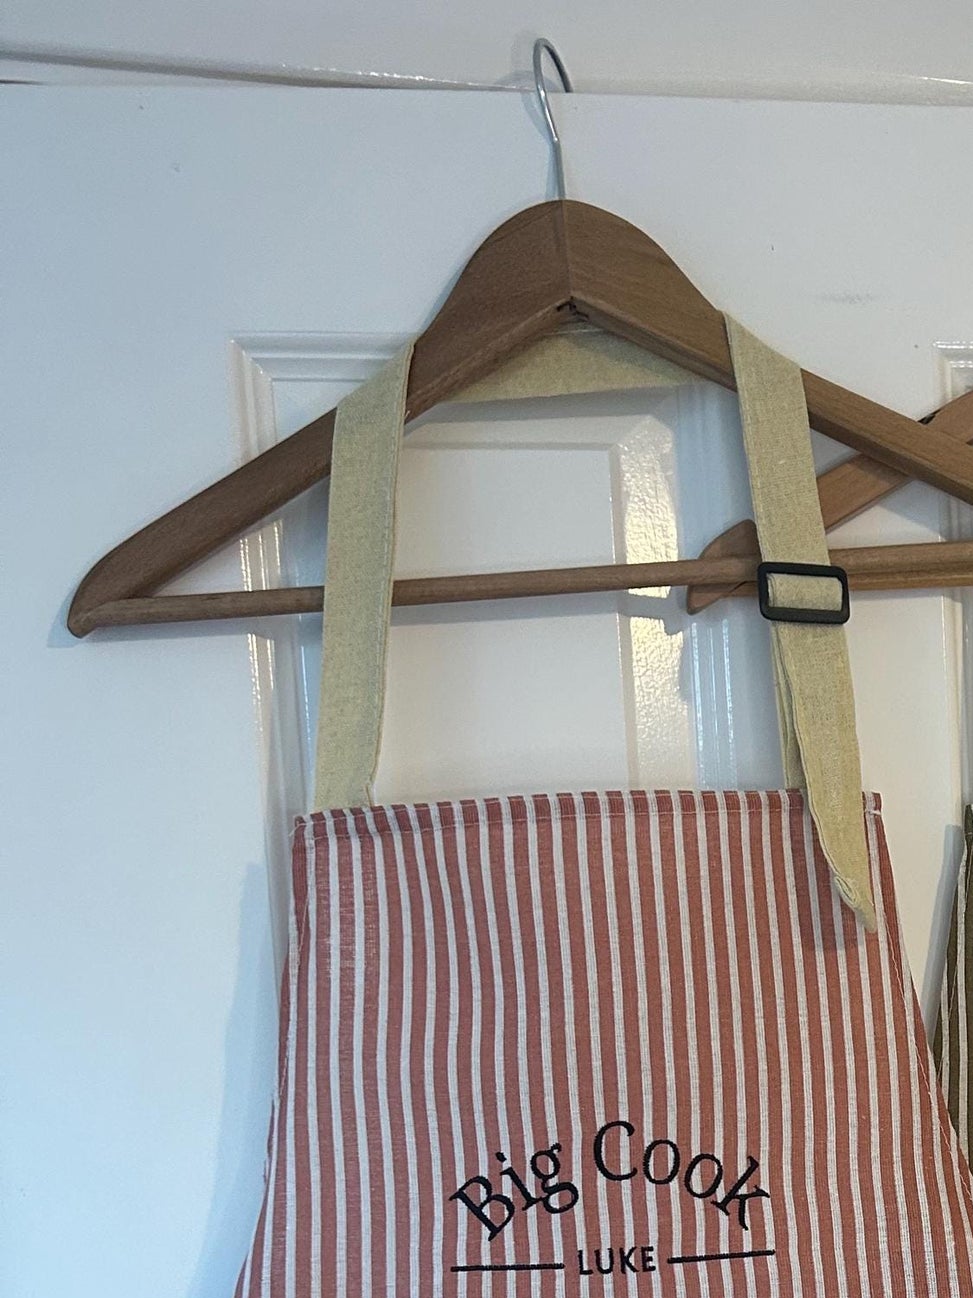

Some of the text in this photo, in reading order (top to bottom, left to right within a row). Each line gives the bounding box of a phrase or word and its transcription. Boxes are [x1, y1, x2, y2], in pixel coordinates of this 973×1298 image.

[449, 1120, 770, 1241] Big Cook
[577, 1246, 656, 1275] LUKE
